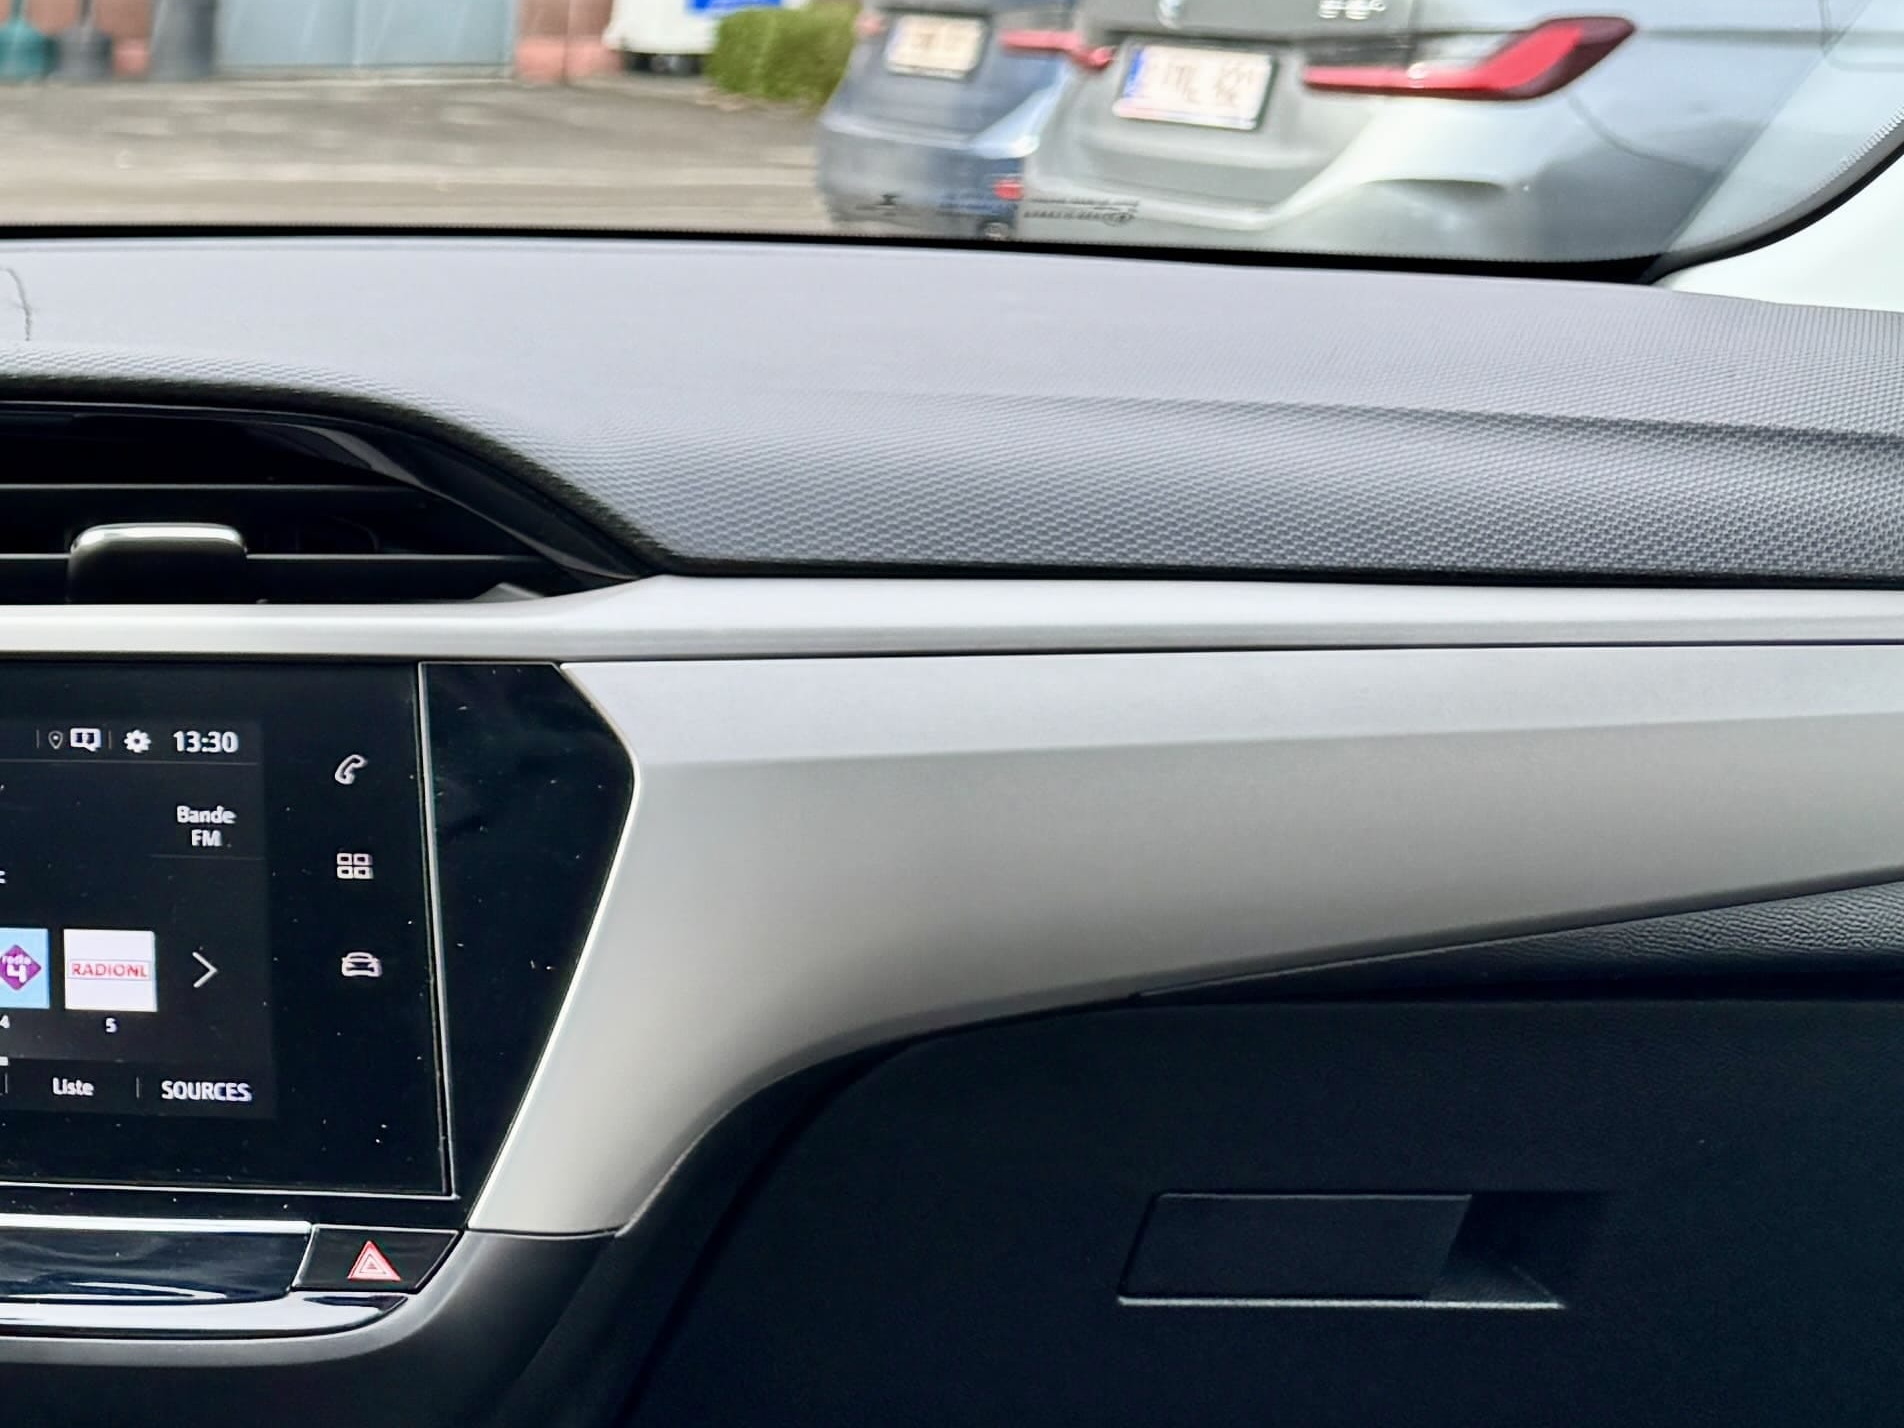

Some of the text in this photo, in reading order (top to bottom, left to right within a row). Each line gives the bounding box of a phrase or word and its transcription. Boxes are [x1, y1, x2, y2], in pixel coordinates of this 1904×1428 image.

[173, 730, 239, 753] 13:30
[176, 804, 236, 824] Bande
[191, 829, 223, 847] FM
[6, 964, 28, 984] 4
[71, 961, 149, 978] RADIONL
[0, 1014, 10, 1029] 4
[105, 1018, 117, 1033] 5
[52, 1077, 95, 1097] Liste
[161, 1080, 253, 1103] SOURCES
